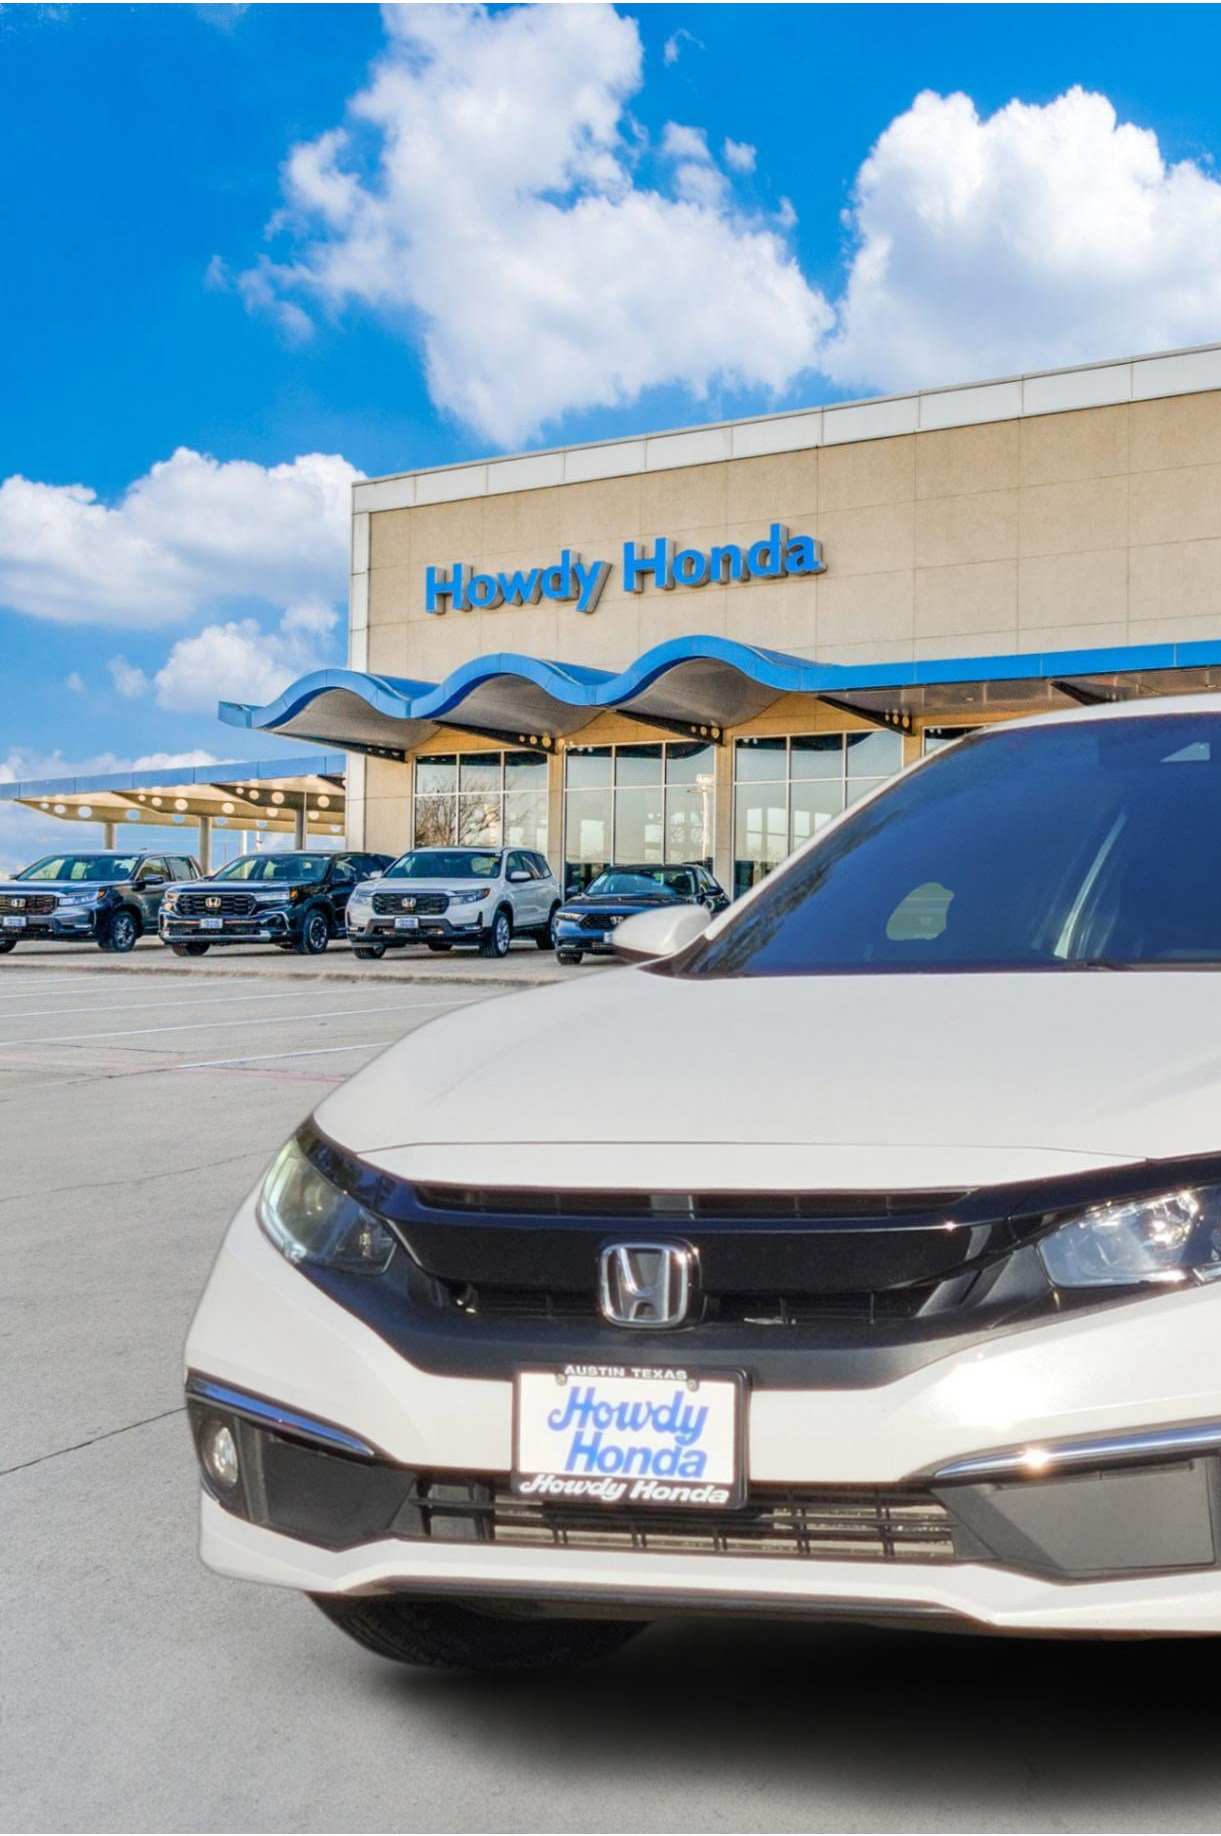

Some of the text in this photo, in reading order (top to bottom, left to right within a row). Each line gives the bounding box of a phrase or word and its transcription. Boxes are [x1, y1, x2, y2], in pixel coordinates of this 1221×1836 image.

[425, 522, 827, 615] Howdy Honda
[564, 1364, 689, 1381] AUSTIN TEXAS
[547, 1386, 709, 1447] Howdy
[565, 1431, 707, 1478] Honda
[520, 1474, 729, 1504] Howdy Honda
